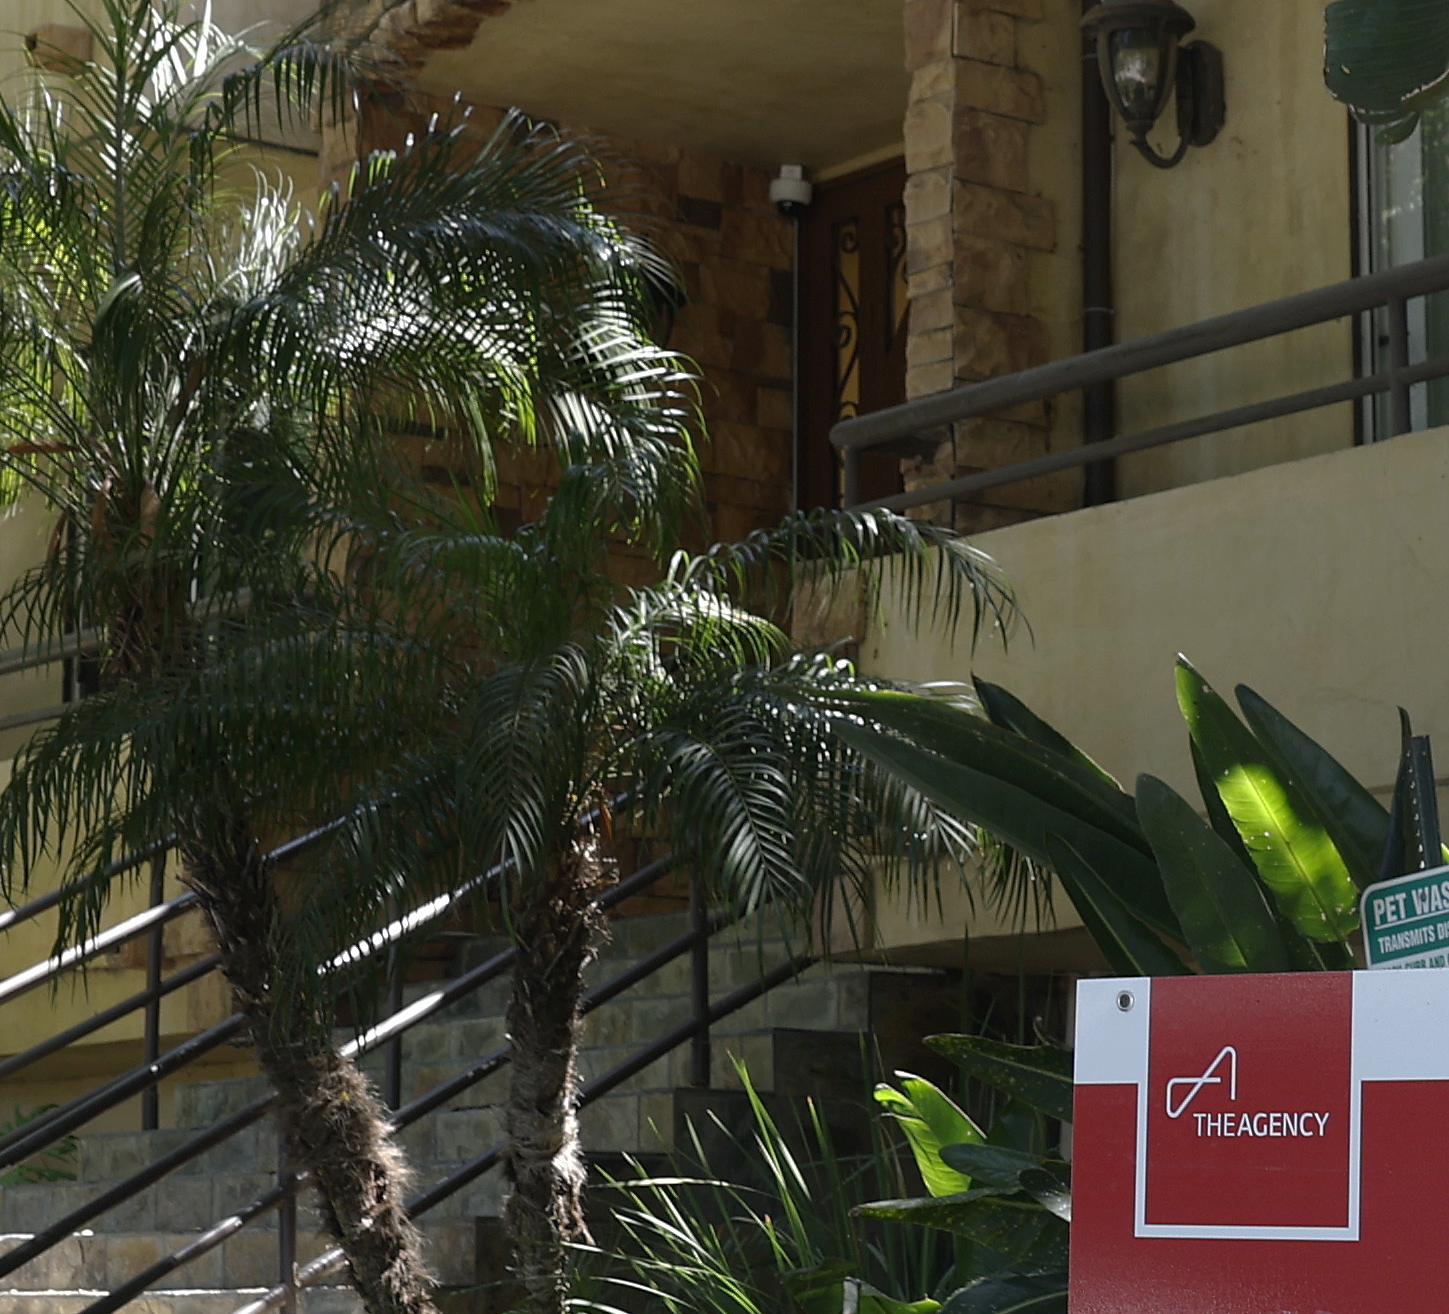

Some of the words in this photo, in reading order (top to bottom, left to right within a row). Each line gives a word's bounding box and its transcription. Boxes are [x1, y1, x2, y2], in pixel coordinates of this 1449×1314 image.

[1372, 892, 1407, 926] PET
[1377, 925, 1436, 955] TRANSMITS
[1429, 954, 1446, 969] AND
[1192, 1112, 1330, 1137] THEAGENCY
